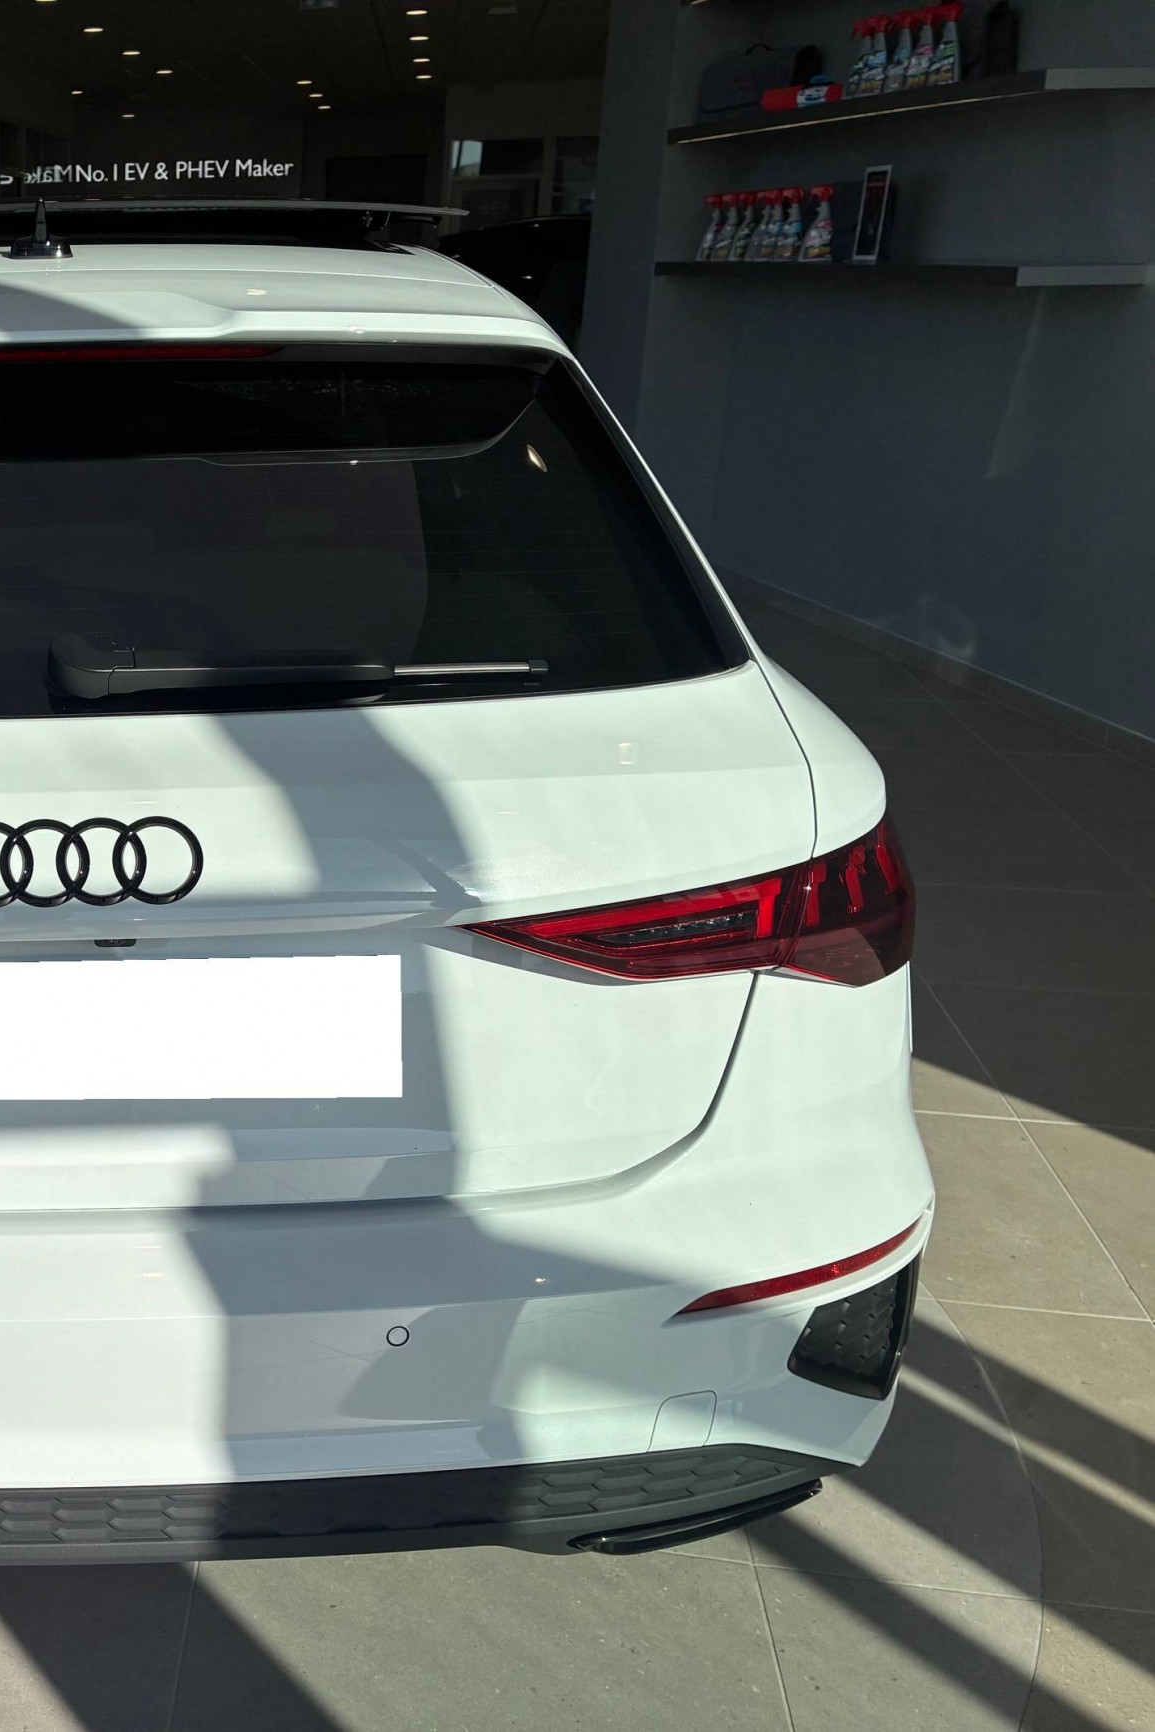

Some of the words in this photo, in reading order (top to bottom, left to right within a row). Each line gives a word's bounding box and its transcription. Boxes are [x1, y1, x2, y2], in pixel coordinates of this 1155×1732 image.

[75, 164, 109, 183] No.
[124, 162, 150, 181] EV
[154, 162, 169, 181] &
[175, 159, 230, 180] PHEV
[235, 158, 294, 178] Maker
